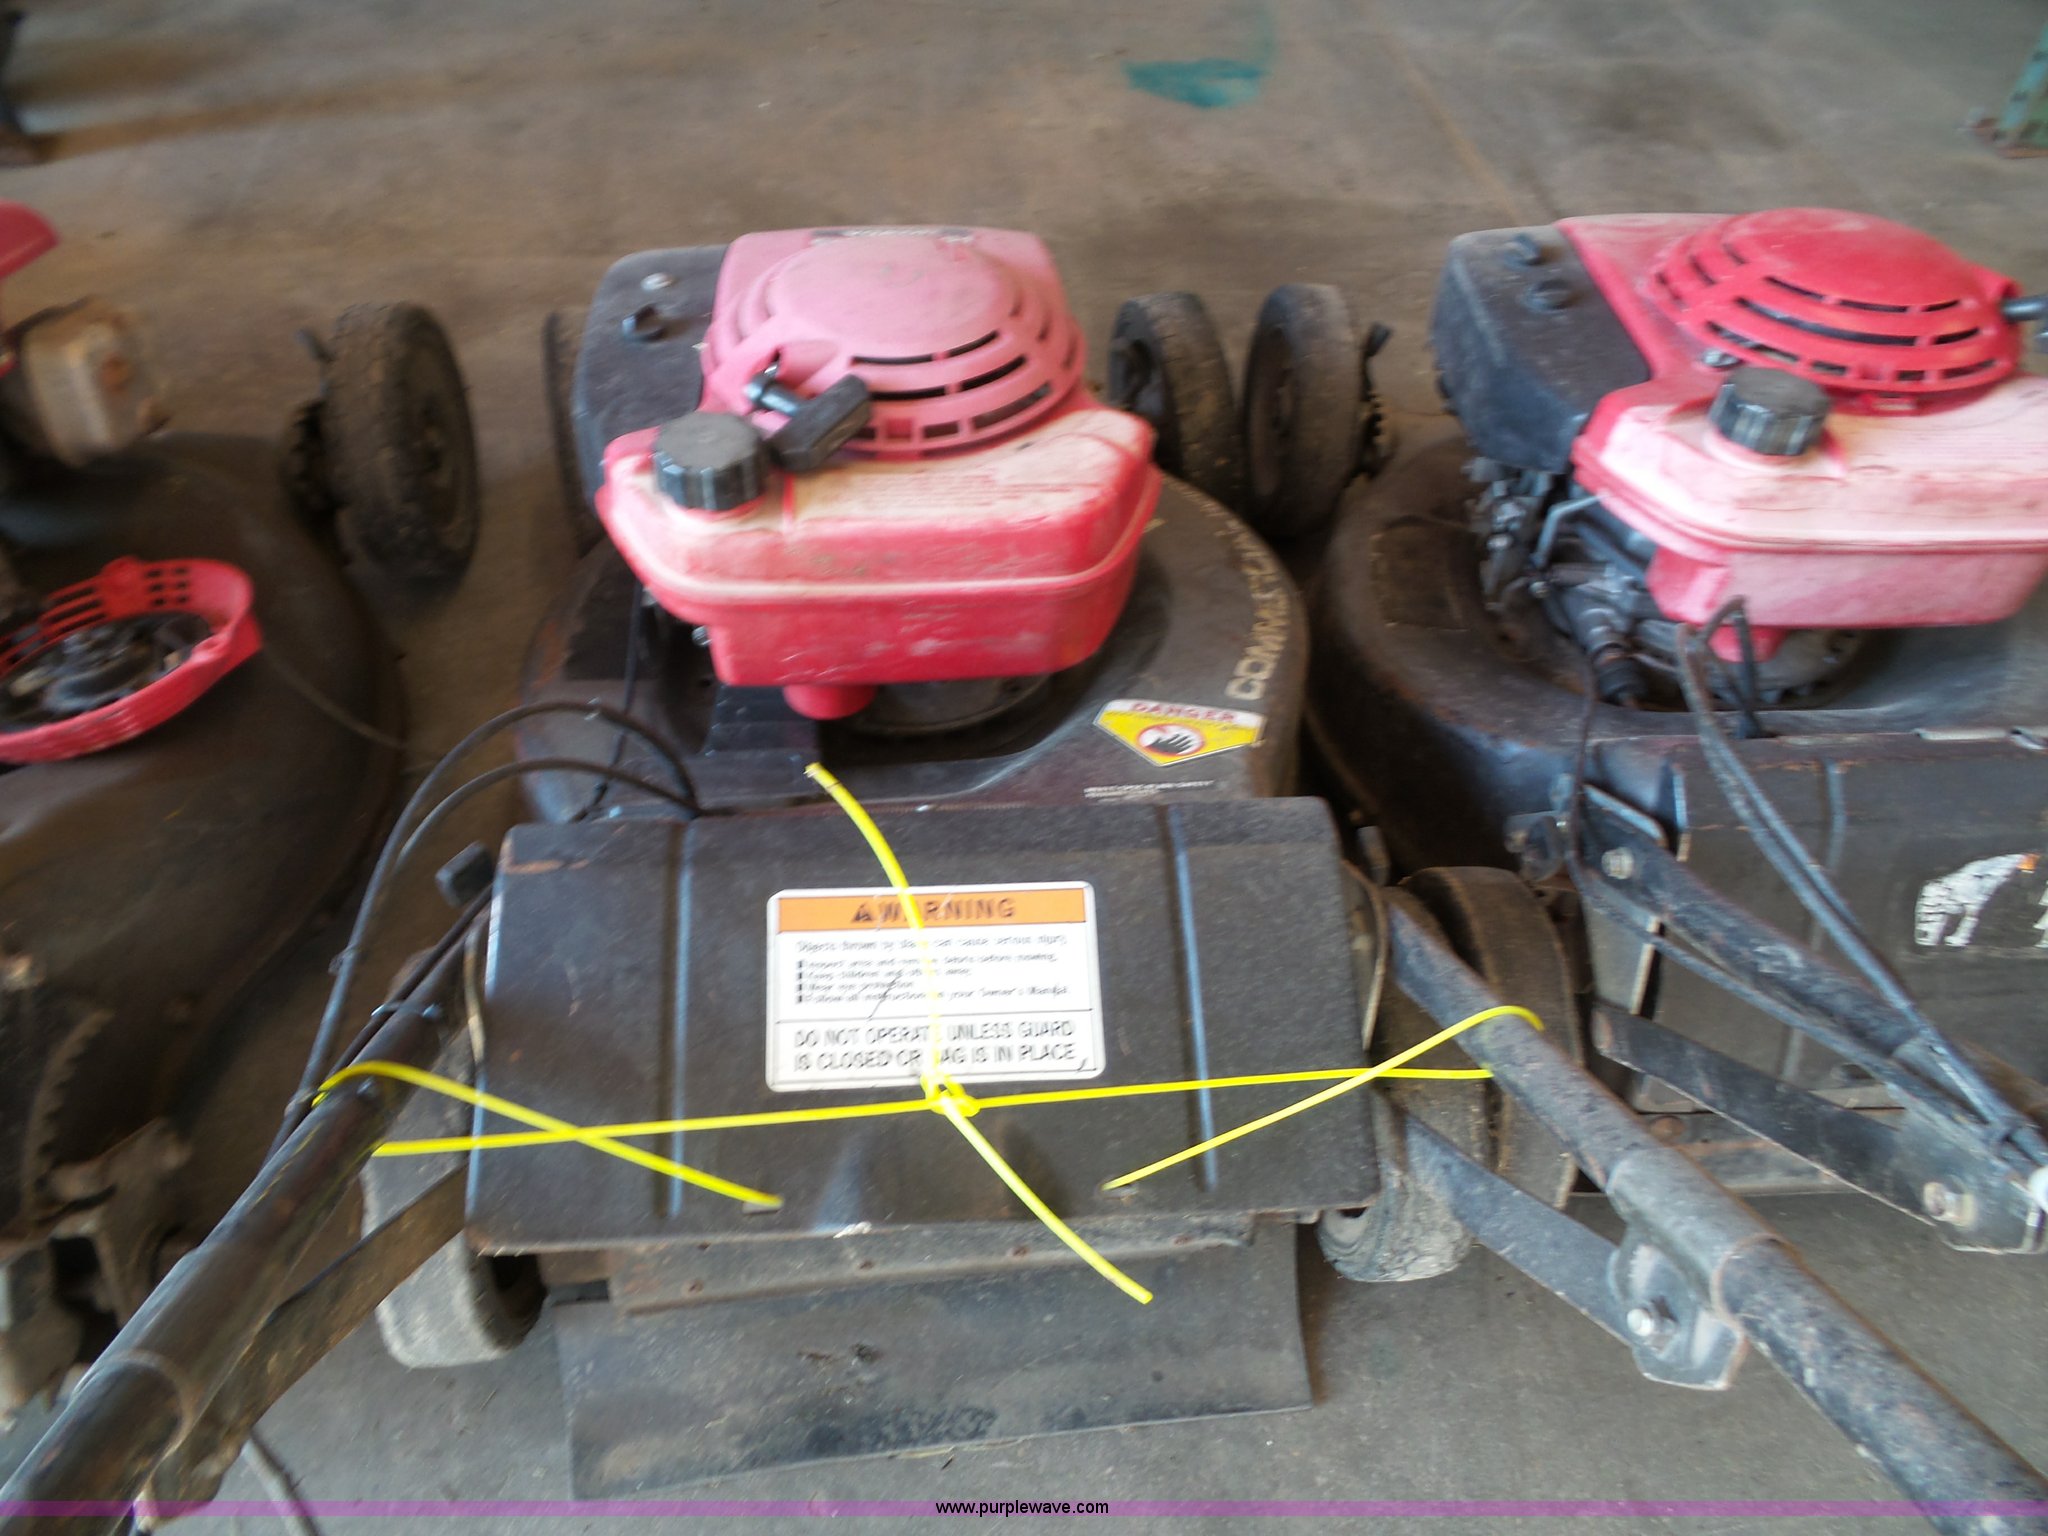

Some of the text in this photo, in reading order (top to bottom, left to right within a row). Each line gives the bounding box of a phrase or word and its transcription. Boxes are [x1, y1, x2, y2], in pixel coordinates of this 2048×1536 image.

[1131, 702, 1237, 722] DANGER
[879, 896, 1016, 923] WRNING
[794, 1019, 1075, 1048] DO NOT OPERAT UNLESS GUARD
[794, 1042, 1077, 1071] IS CLOSED OR AG IS IN PLACE
